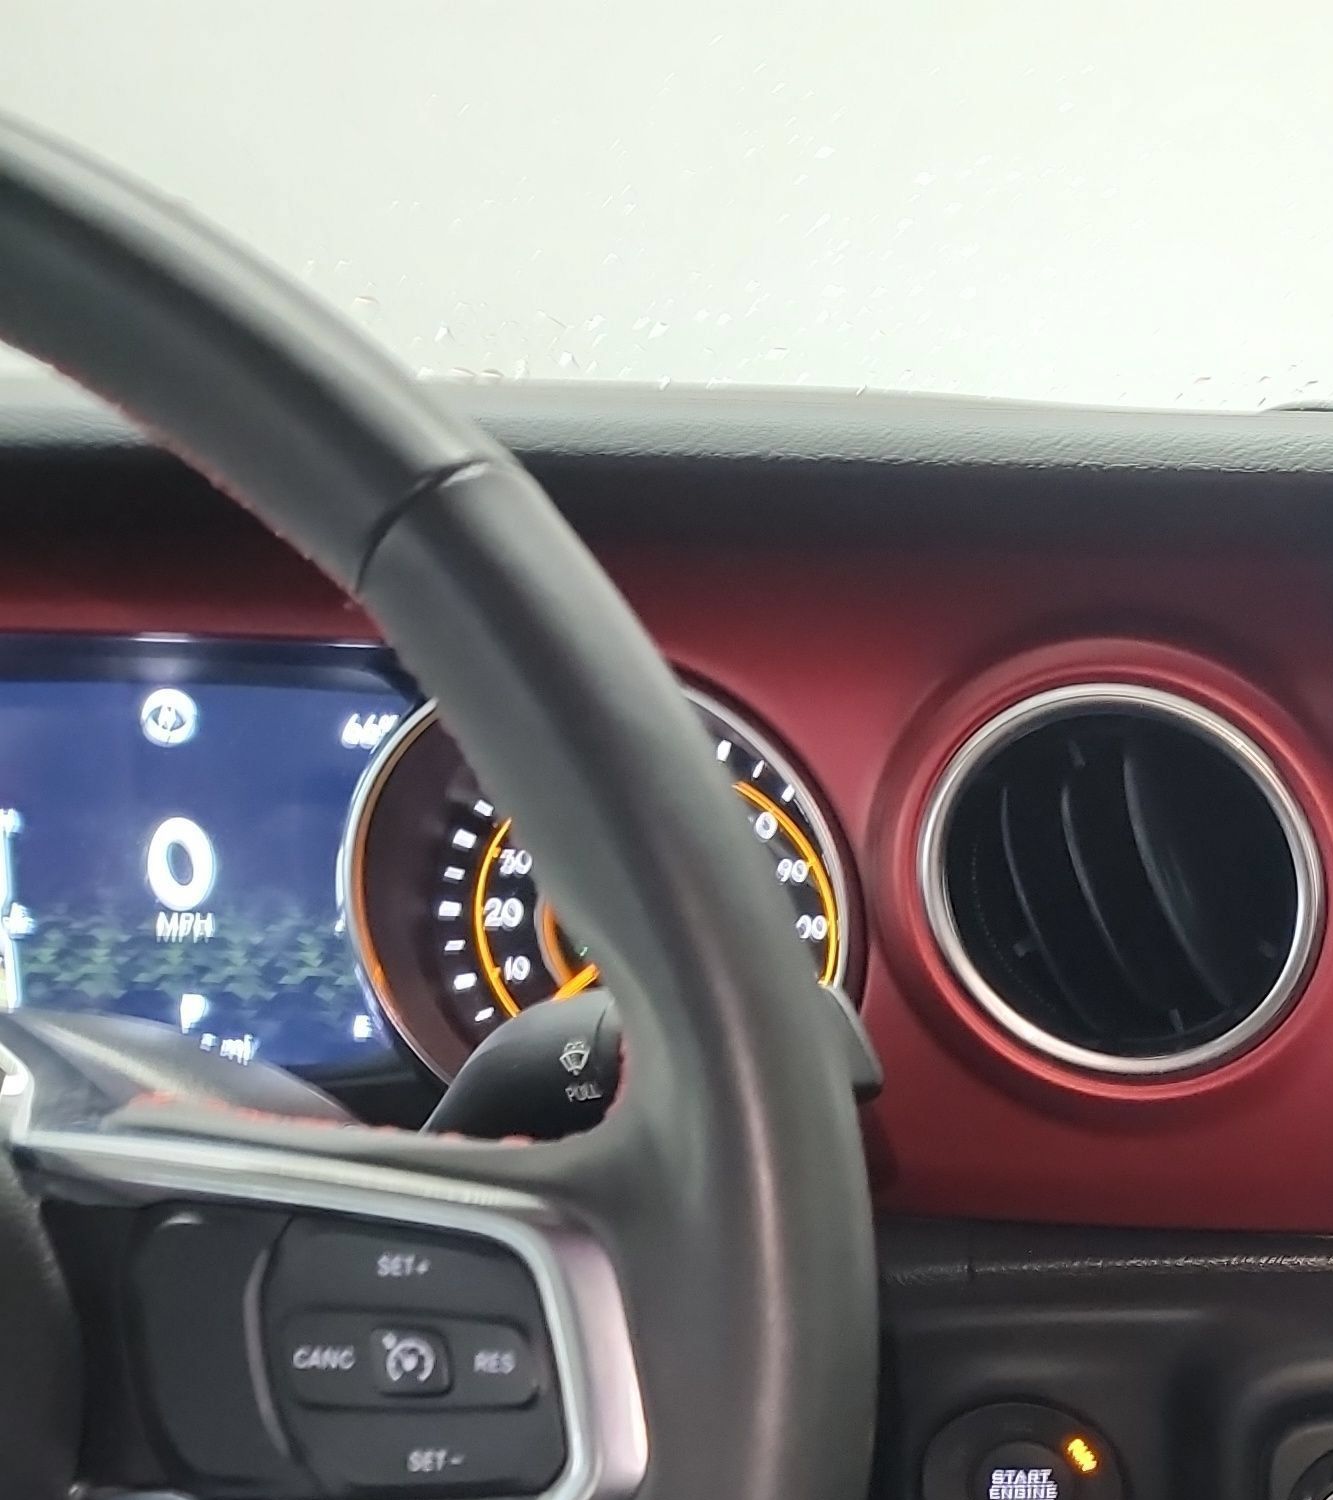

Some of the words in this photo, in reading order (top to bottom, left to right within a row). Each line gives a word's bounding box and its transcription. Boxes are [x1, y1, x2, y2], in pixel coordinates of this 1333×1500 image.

[147, 817, 215, 911] 0
[776, 858, 810, 884] 90
[484, 897, 524, 928] 20
[155, 911, 216, 943] MPH
[503, 955, 532, 982] 10
[473, 1351, 516, 1375] RES
[991, 1468, 1053, 1486] START
[989, 1485, 1058, 1500] ENGINE
